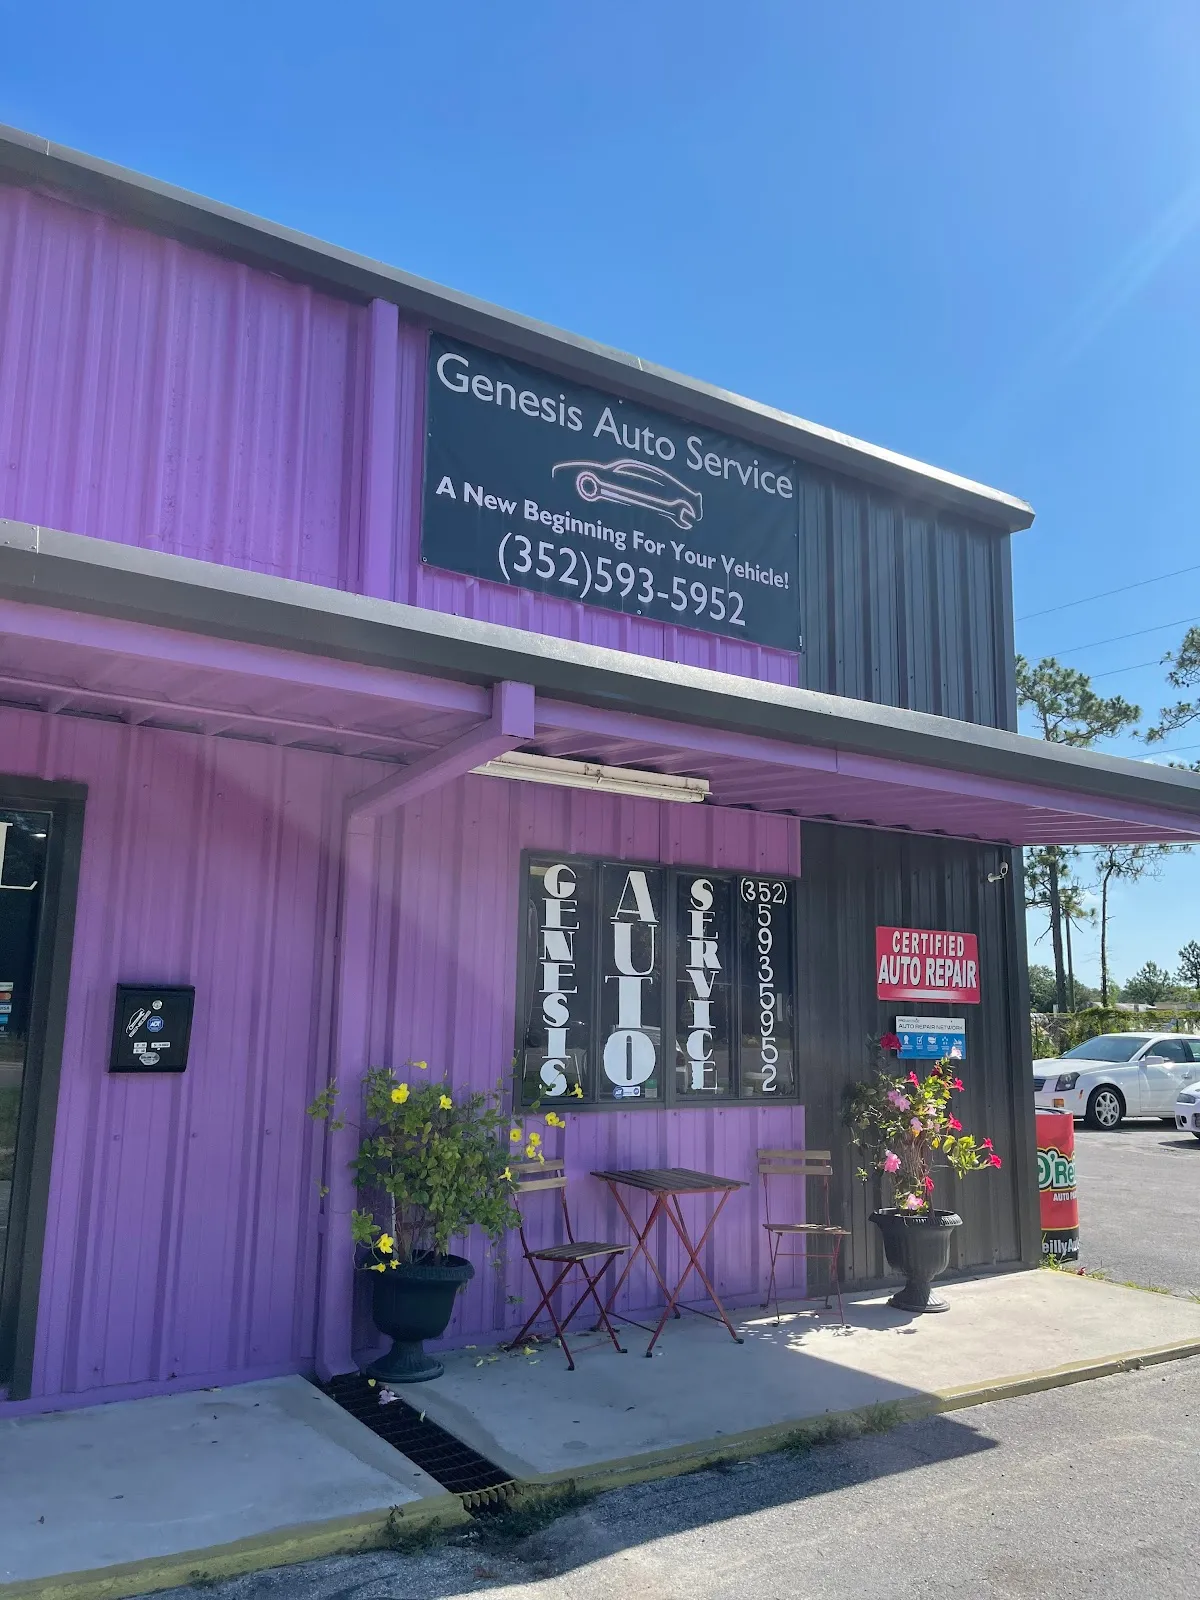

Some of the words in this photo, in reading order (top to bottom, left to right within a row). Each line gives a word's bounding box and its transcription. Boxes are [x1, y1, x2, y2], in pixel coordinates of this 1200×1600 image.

[436, 352, 583, 431] Genesis
[593, 407, 676, 461] Auto
[686, 435, 793, 499] Service
[436, 476, 457, 500] A
[464, 482, 517, 515] New
[524, 499, 627, 550] Beginning
[633, 531, 666, 556] For
[670, 541, 717, 571] Your
[721, 555, 790, 590] Vehicle!
[498, 532, 746, 627] (352)593-5952
[740, 877, 787, 905] (352)
[892, 930, 965, 957] CERTIFIED
[539, 864, 580, 1097] GENESIS
[603, 870, 660, 1087] AUTO
[686, 878, 723, 1094] SERVICE
[757, 904, 779, 1092] 5935952
[878, 954, 921, 986] AUTO
[925, 957, 977, 989] REPAIR
[1052, 1192, 1070, 1202] AUTO
